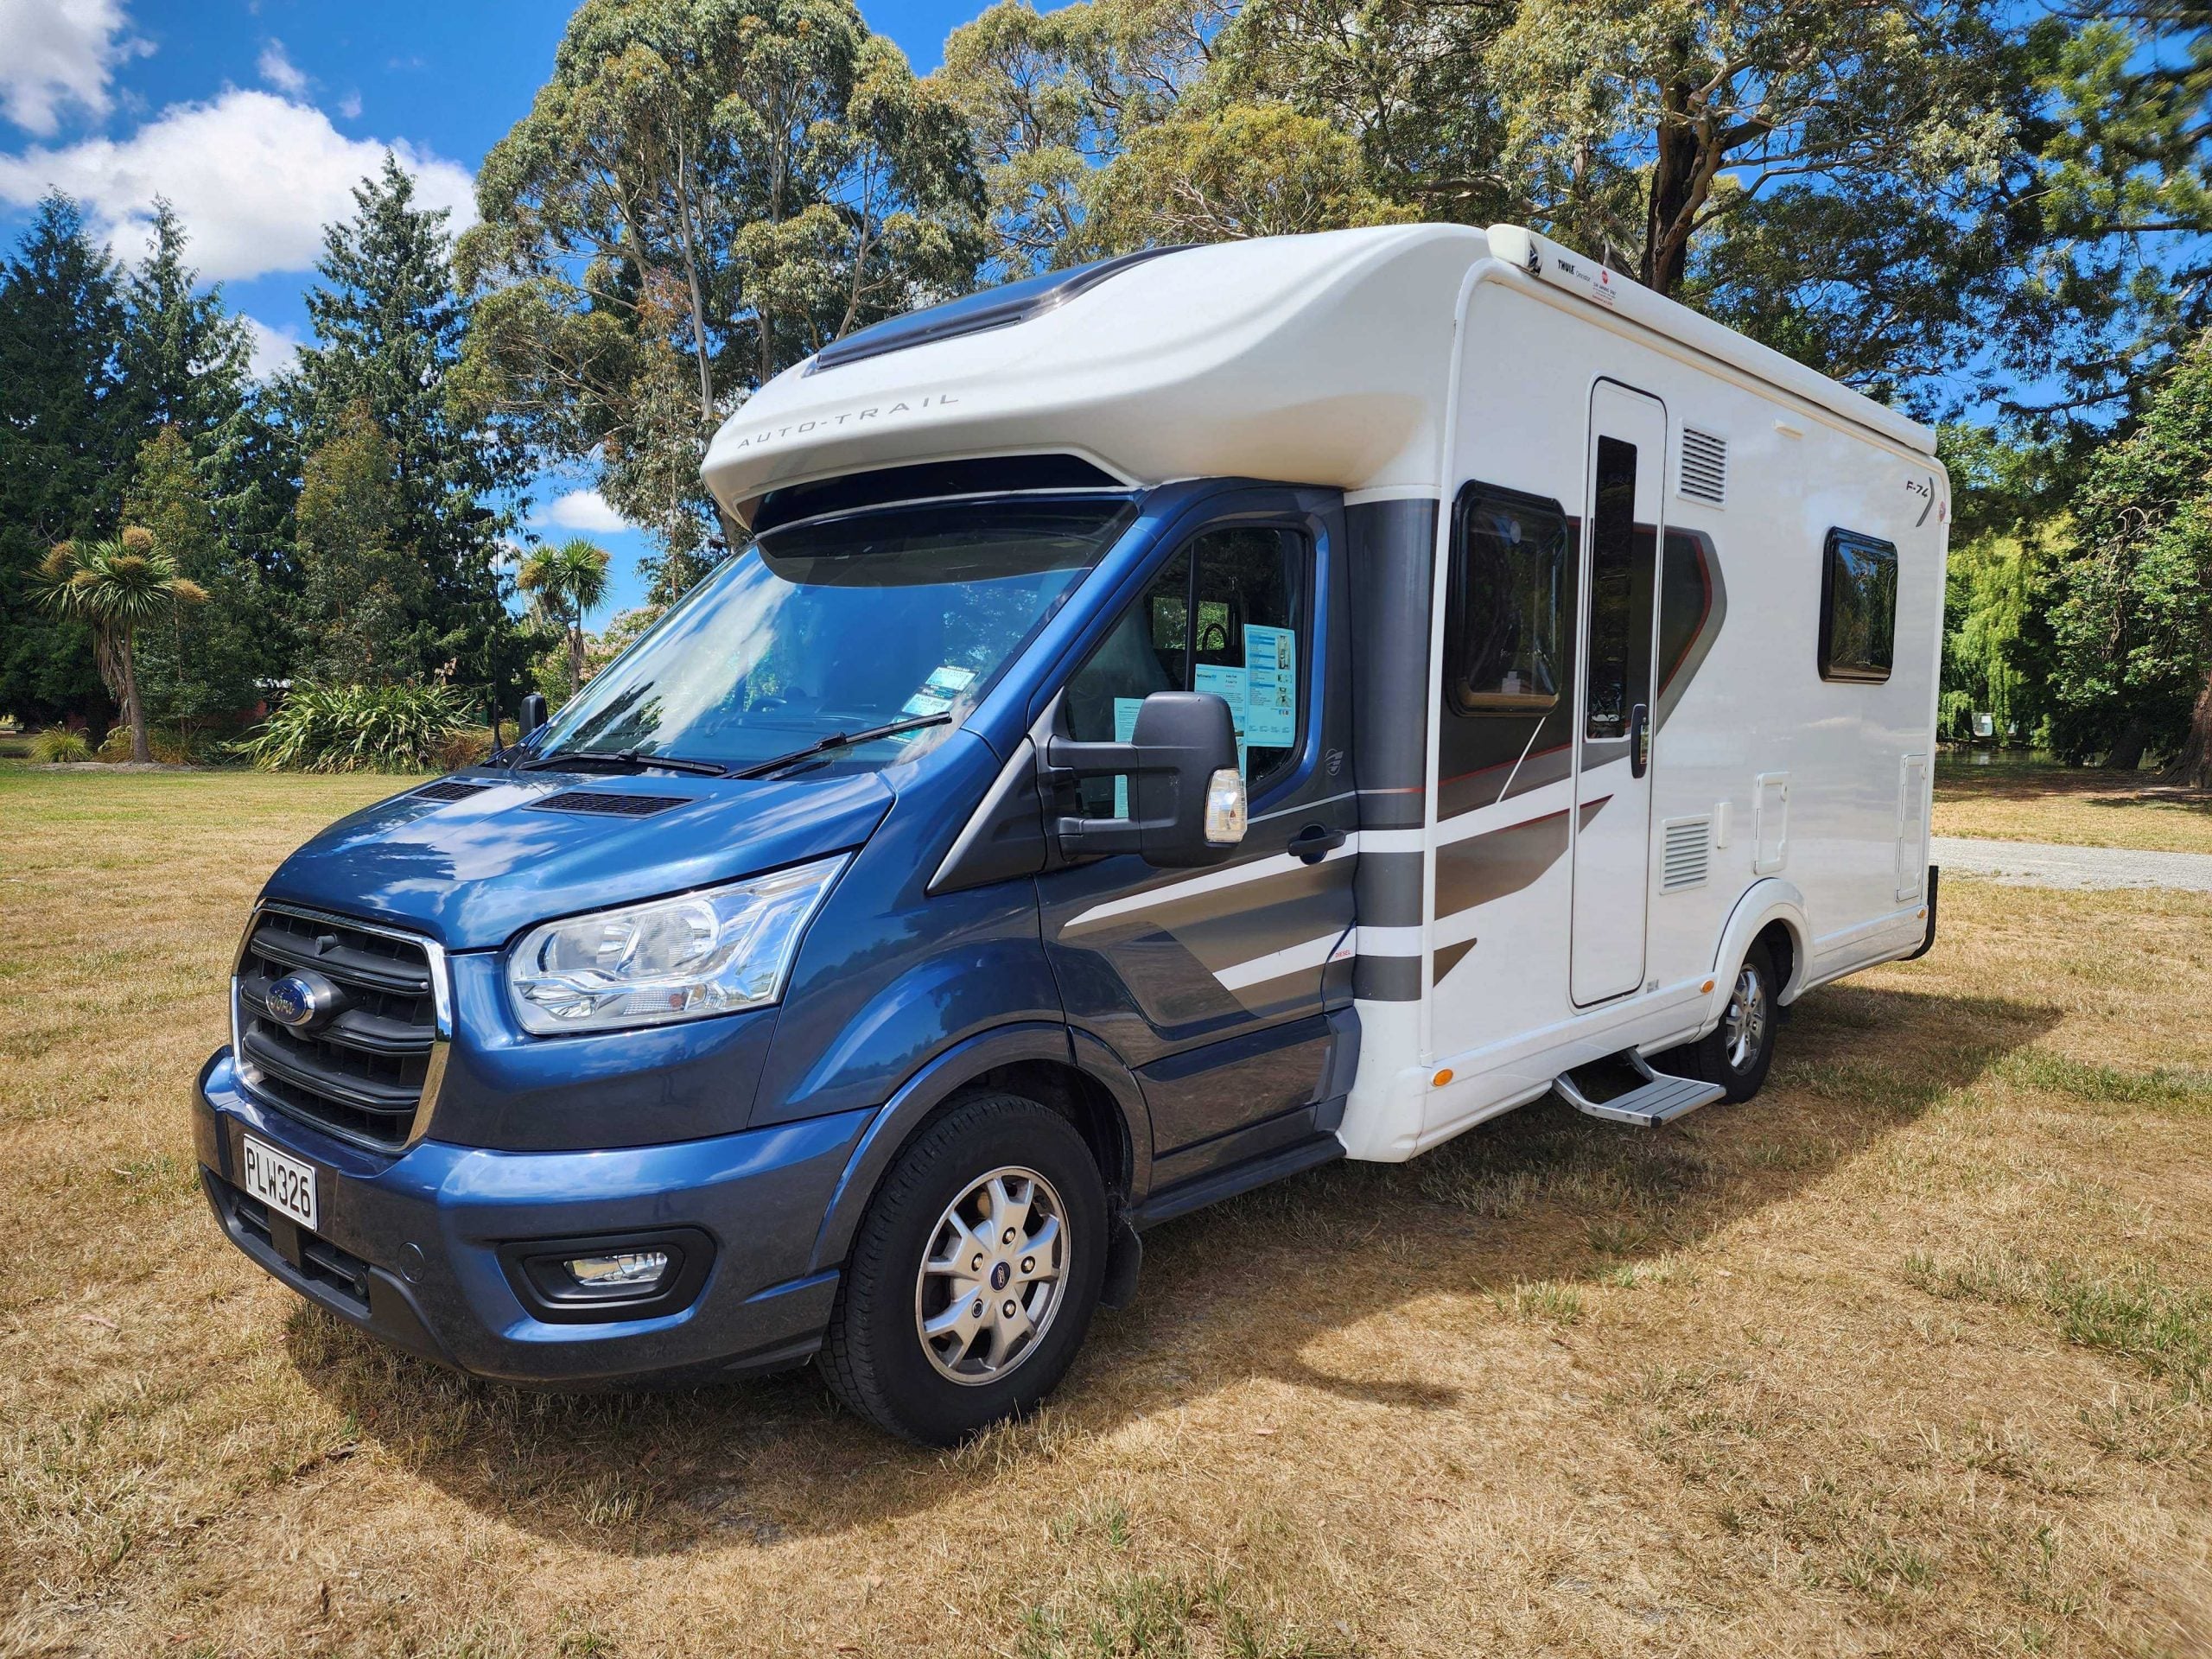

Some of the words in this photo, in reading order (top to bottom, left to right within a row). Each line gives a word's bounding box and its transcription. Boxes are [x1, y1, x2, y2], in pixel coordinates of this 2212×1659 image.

[1557, 258, 1576, 276] THULE
[737, 394, 959, 449] AUTO-TRAIL
[1905, 480, 1929, 499] F-74
[1335, 950, 1351, 958] DIESEL
[270, 986, 297, 1015] Ford
[246, 1147, 311, 1218] PLW326
